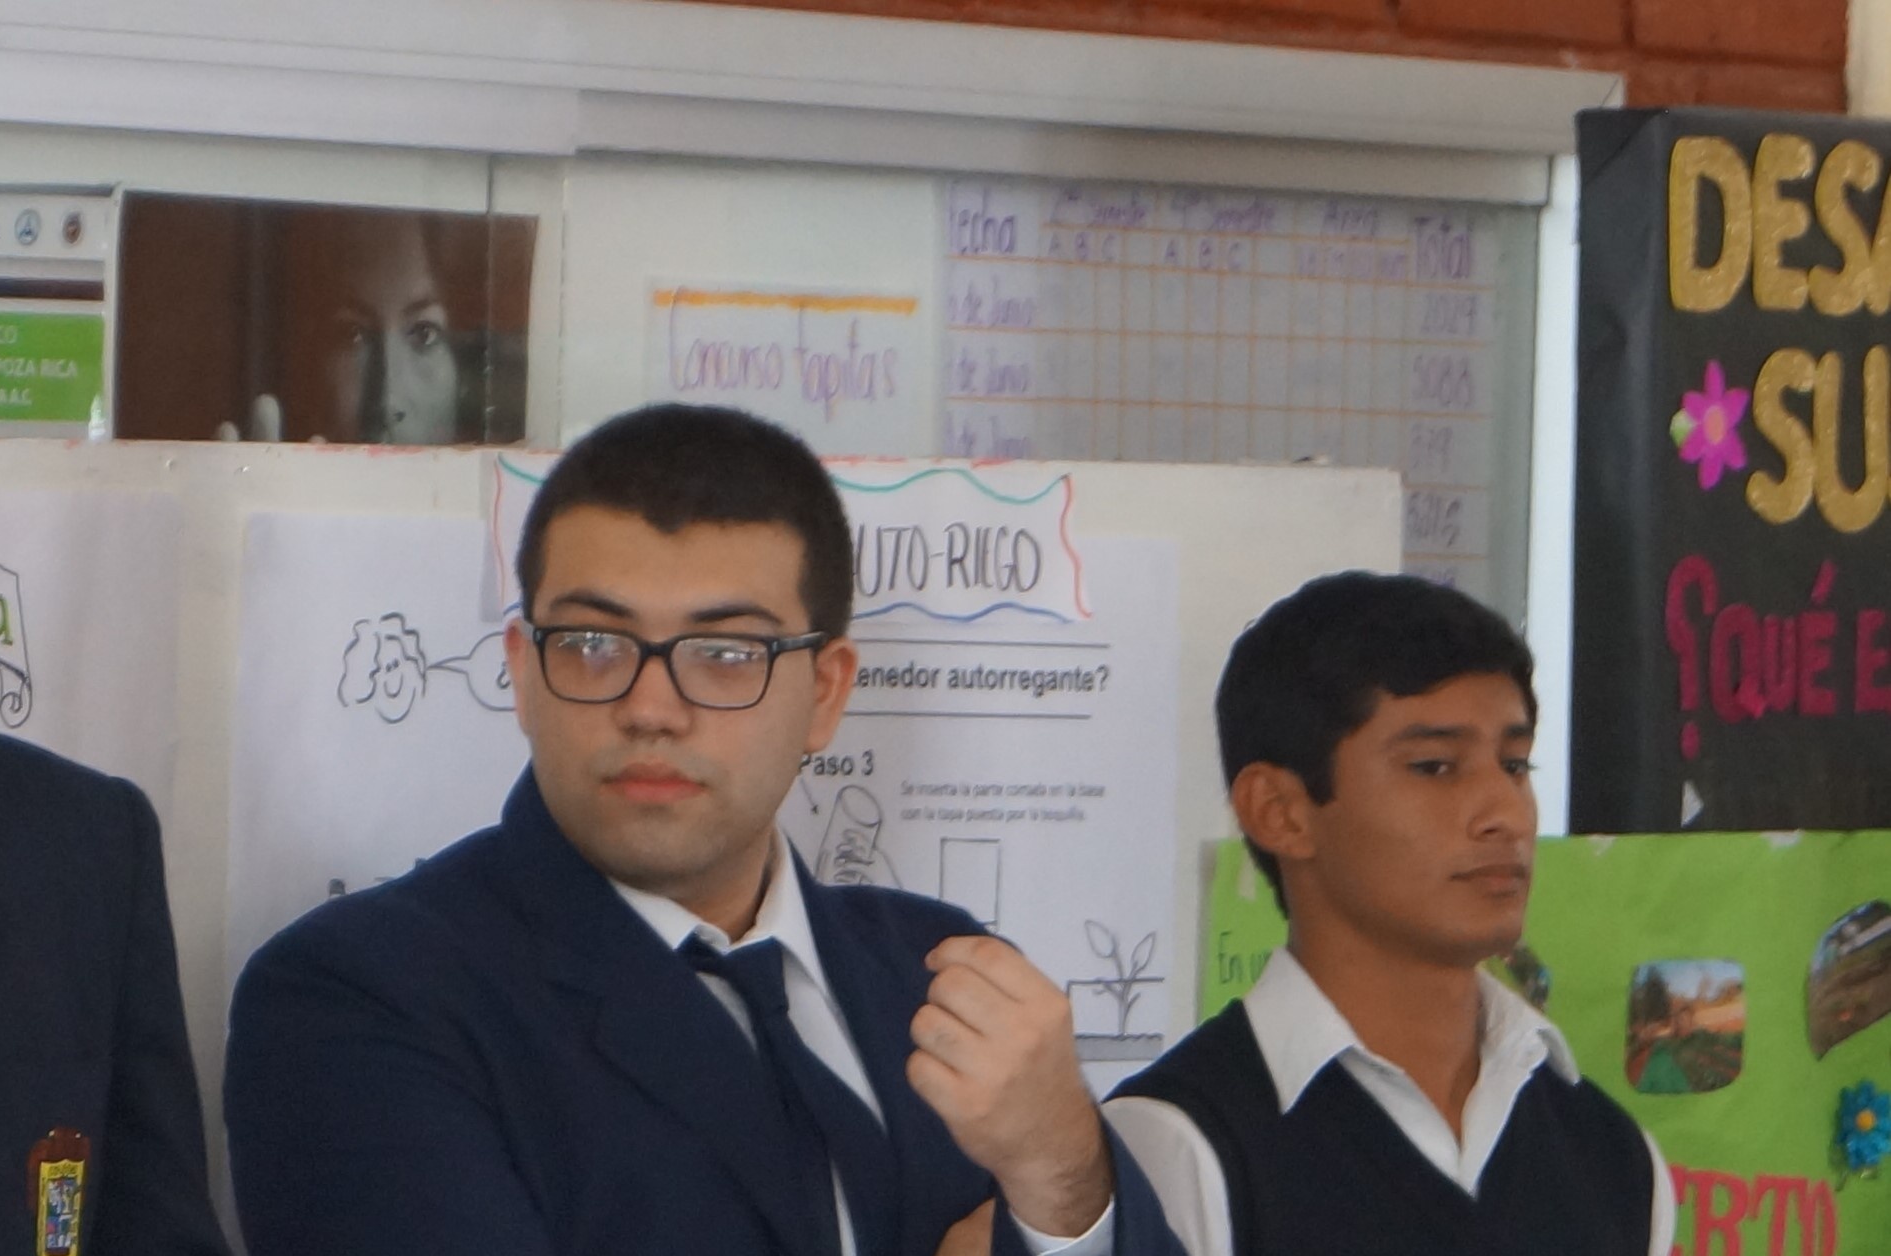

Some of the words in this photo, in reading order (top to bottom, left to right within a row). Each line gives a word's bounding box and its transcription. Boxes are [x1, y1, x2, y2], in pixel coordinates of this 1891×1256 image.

[1746, 344, 1891, 534] SU
[853, 522, 1041, 597] UTO-RIEGO
[947, 663, 1110, 699] autorregante?
[862, 748, 875, 776] 3
